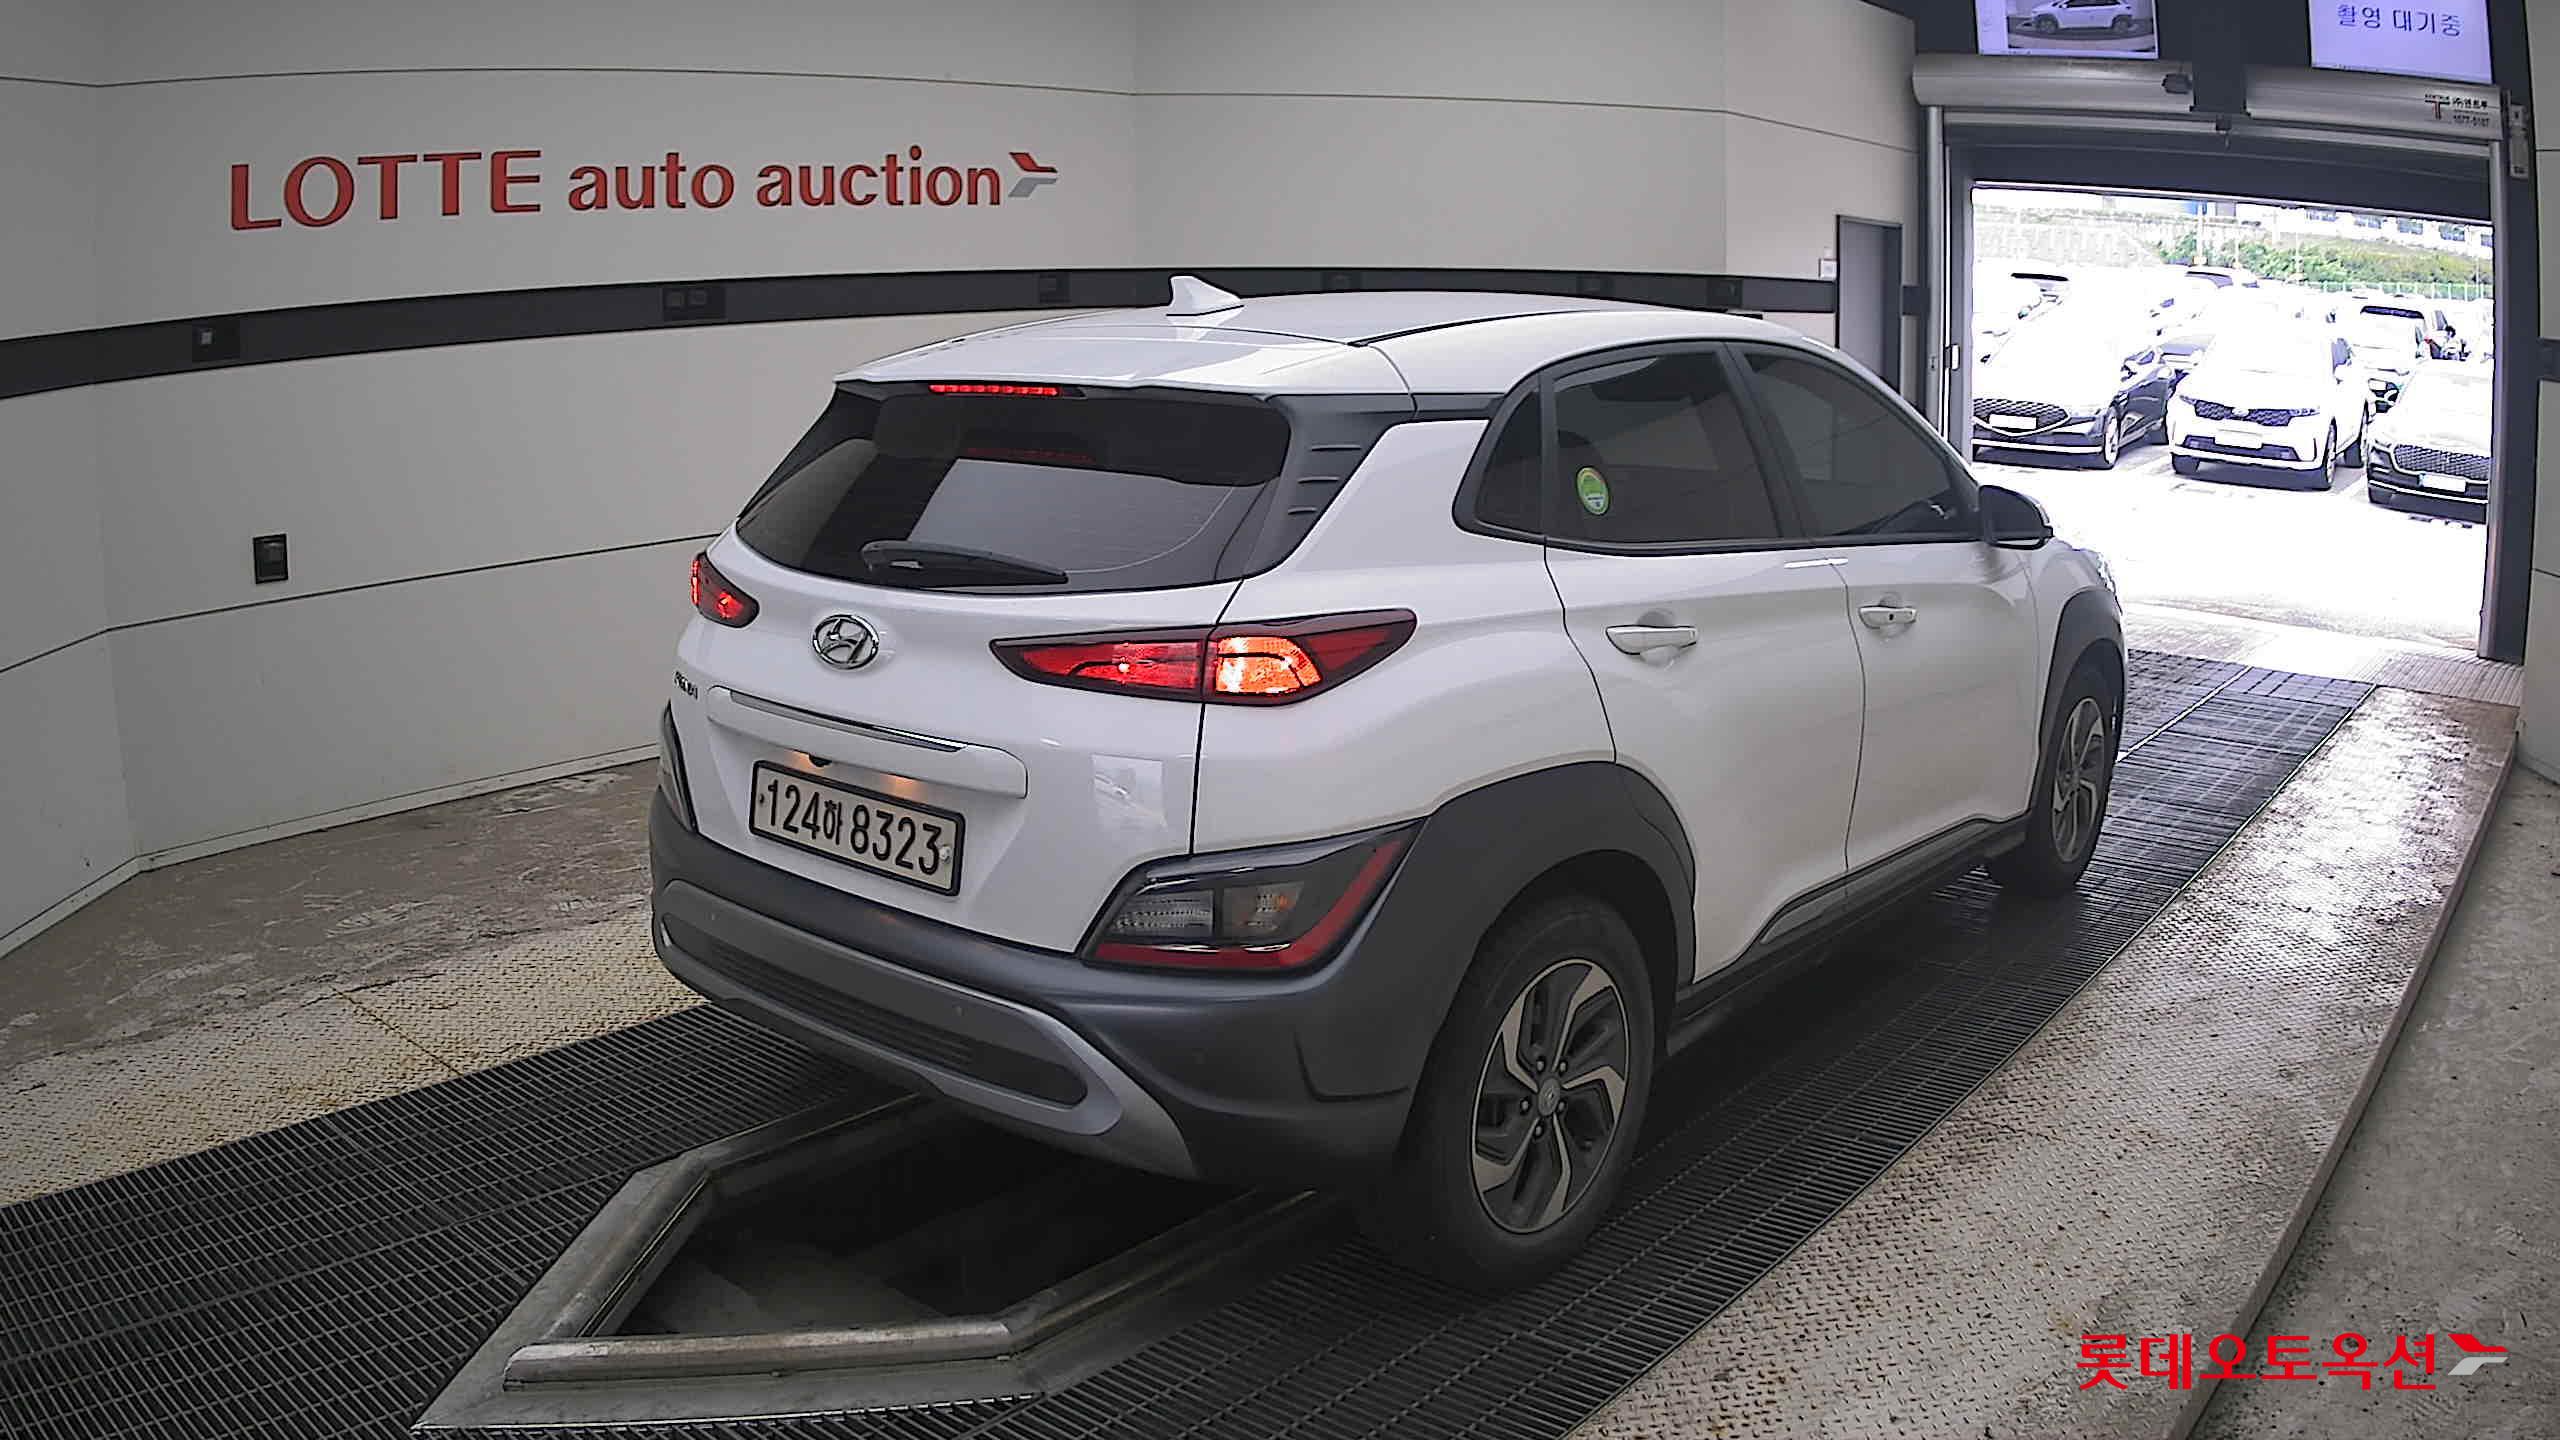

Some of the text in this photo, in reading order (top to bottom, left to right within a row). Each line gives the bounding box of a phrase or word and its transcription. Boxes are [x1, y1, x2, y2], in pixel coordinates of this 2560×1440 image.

[2338, 4, 2461, 37] 촬영 대기중
[231, 145, 1002, 231] LOTTE auto auction
